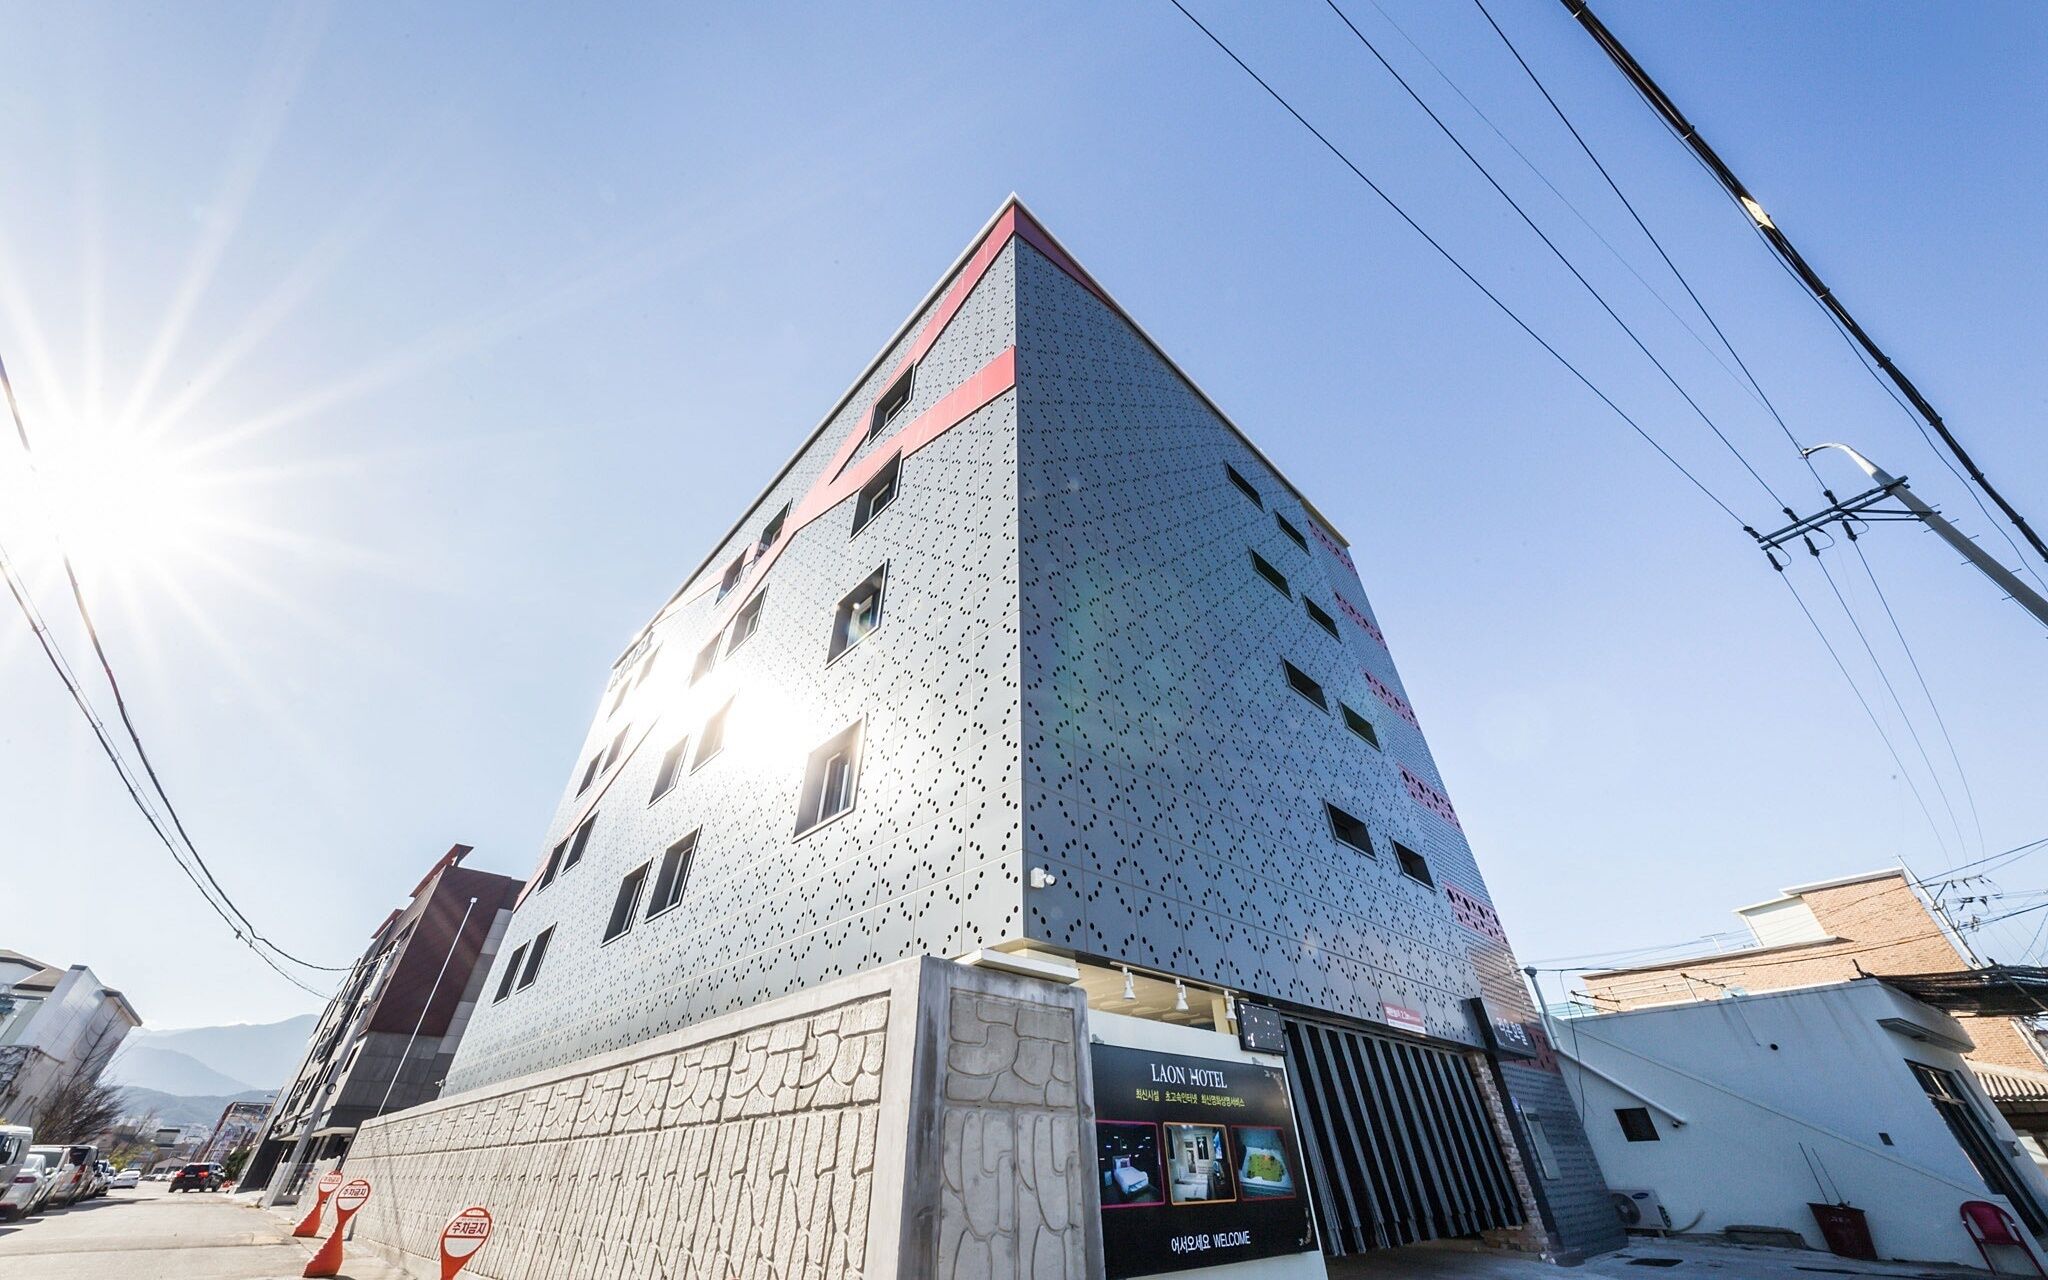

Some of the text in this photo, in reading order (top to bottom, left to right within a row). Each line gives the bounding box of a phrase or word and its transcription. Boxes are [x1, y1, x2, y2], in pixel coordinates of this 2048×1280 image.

[1150, 1063, 1228, 1089] LAON HOTEL
[1135, 1088, 1160, 1102] 최신시설
[1165, 1090, 1198, 1105] 초고속인터넷
[342, 1188, 367, 1197] 주차금지
[452, 1221, 488, 1235] 주차금지
[1171, 1230, 1251, 1255] 어서오세요 WELCOME
